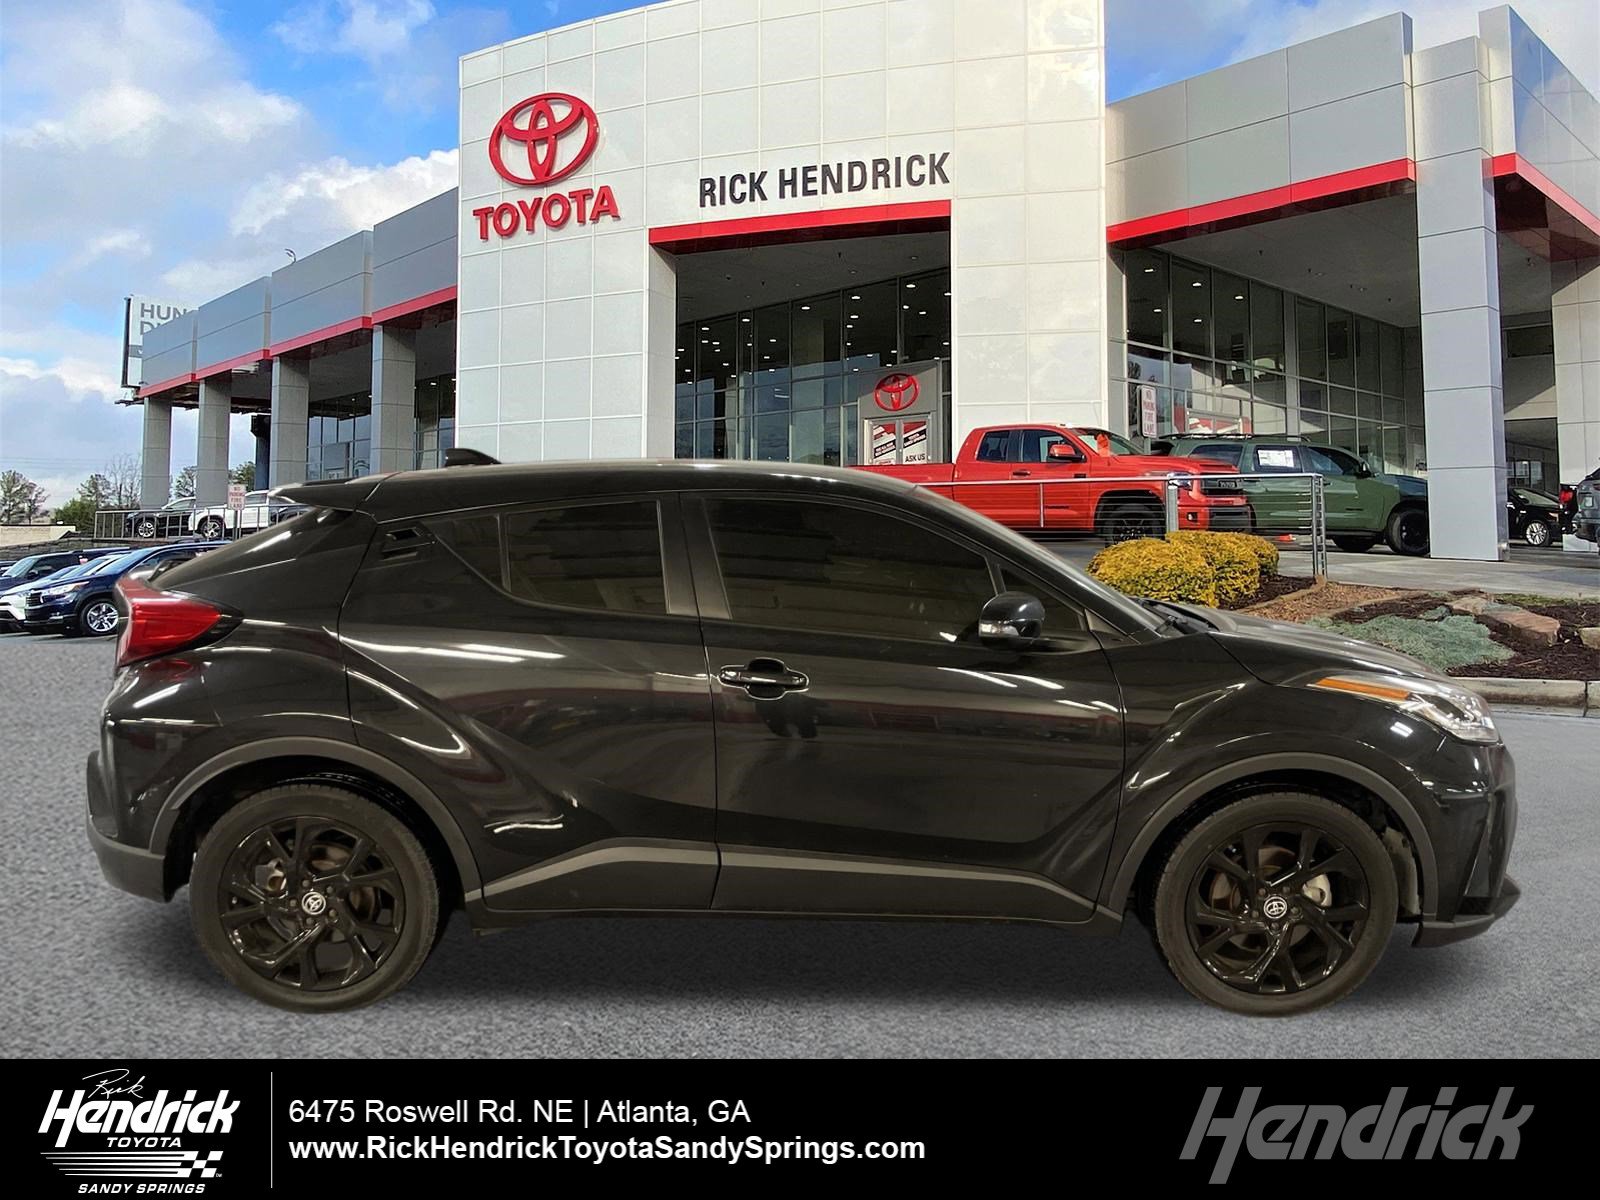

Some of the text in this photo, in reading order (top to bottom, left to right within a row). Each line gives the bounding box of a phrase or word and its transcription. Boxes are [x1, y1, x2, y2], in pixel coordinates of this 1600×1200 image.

[699, 152, 951, 208] RICK HENDRICK
[473, 185, 620, 240] TOYOTA
[905, 453, 926, 463] ASK US
